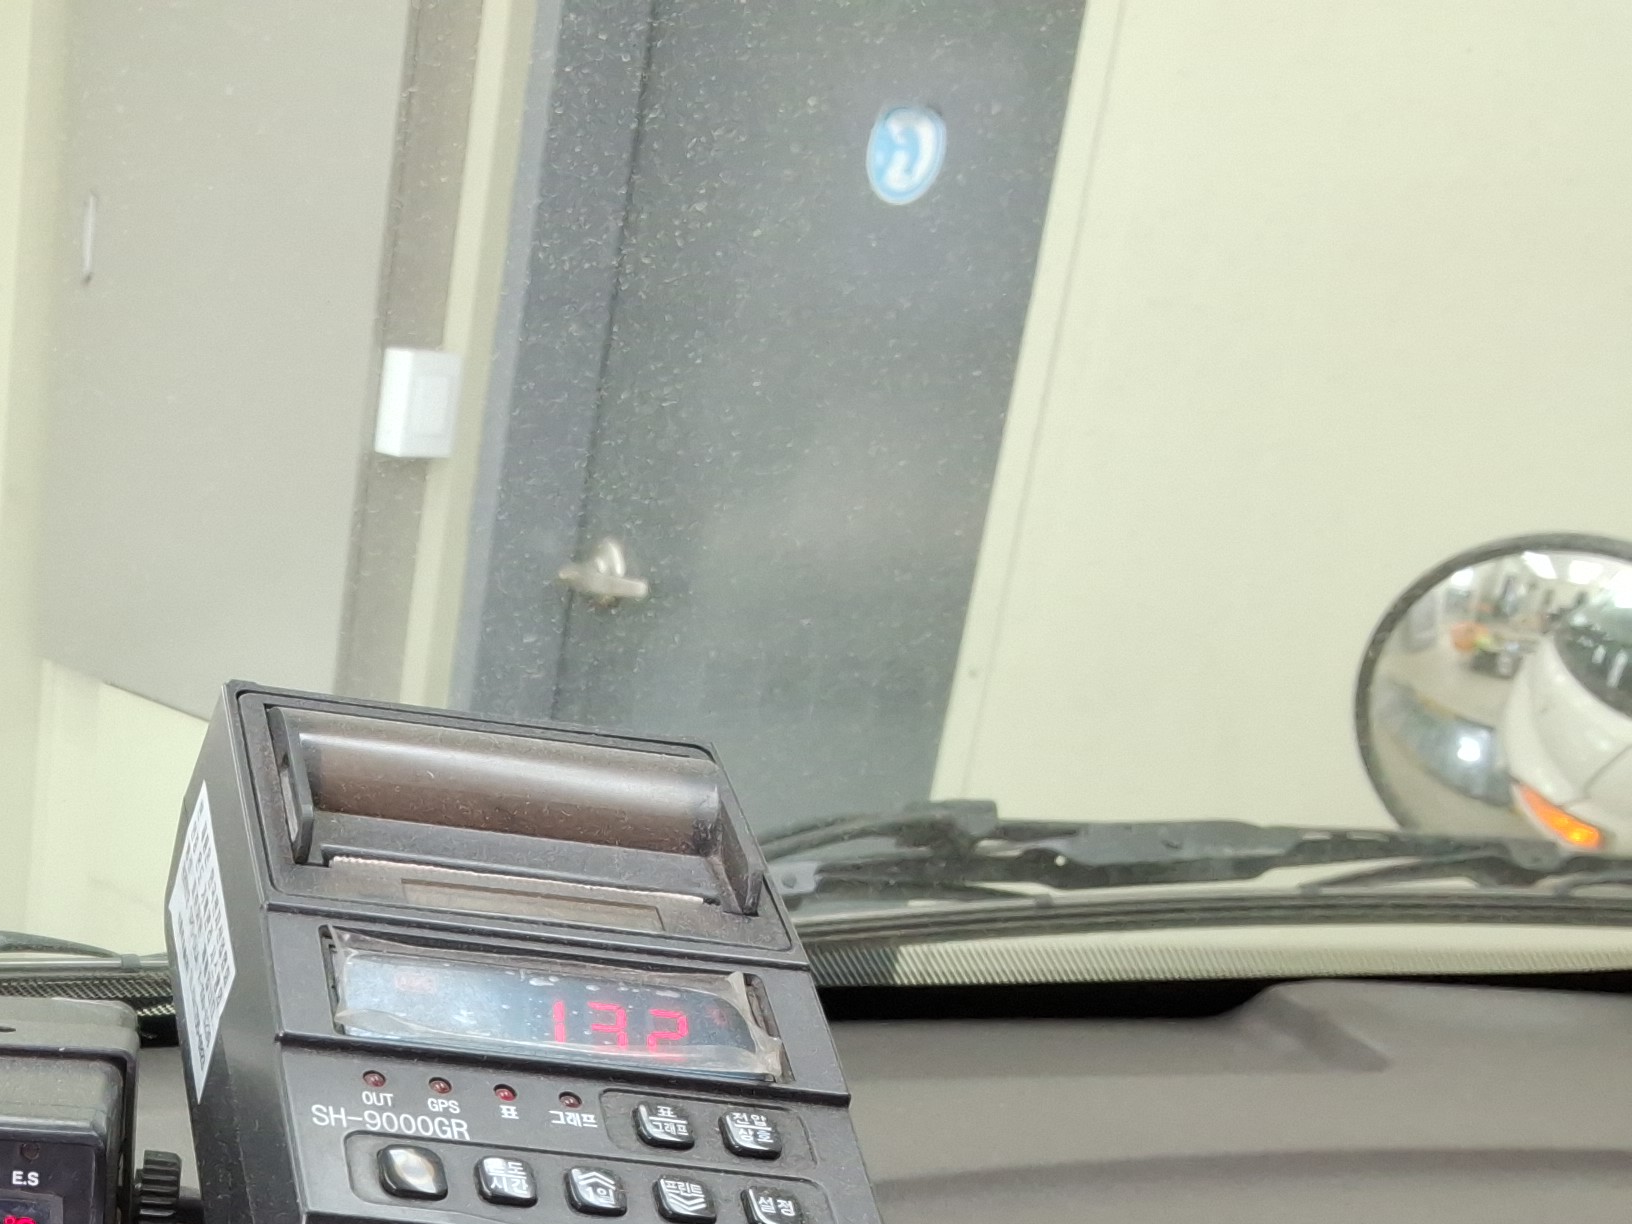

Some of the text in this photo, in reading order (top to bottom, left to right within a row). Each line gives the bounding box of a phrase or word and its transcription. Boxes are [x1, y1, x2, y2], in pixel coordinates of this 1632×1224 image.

[361, 1091, 394, 1107] OUT
[428, 1098, 460, 1114] GPS
[499, 1105, 519, 1119] 표
[548, 1110, 598, 1128] 그래프
[657, 1105, 677, 1118] 표
[732, 1112, 767, 1127] 전압
[311, 1104, 470, 1141] SH-9000GR
[652, 1122, 689, 1136] 그래프
[738, 1129, 774, 1143] 상호
[12, 1170, 39, 1186] E.S
[490, 1177, 528, 1195] 시간
[666, 1180, 705, 1198] 프린트
[759, 1196, 795, 1217] 설정
